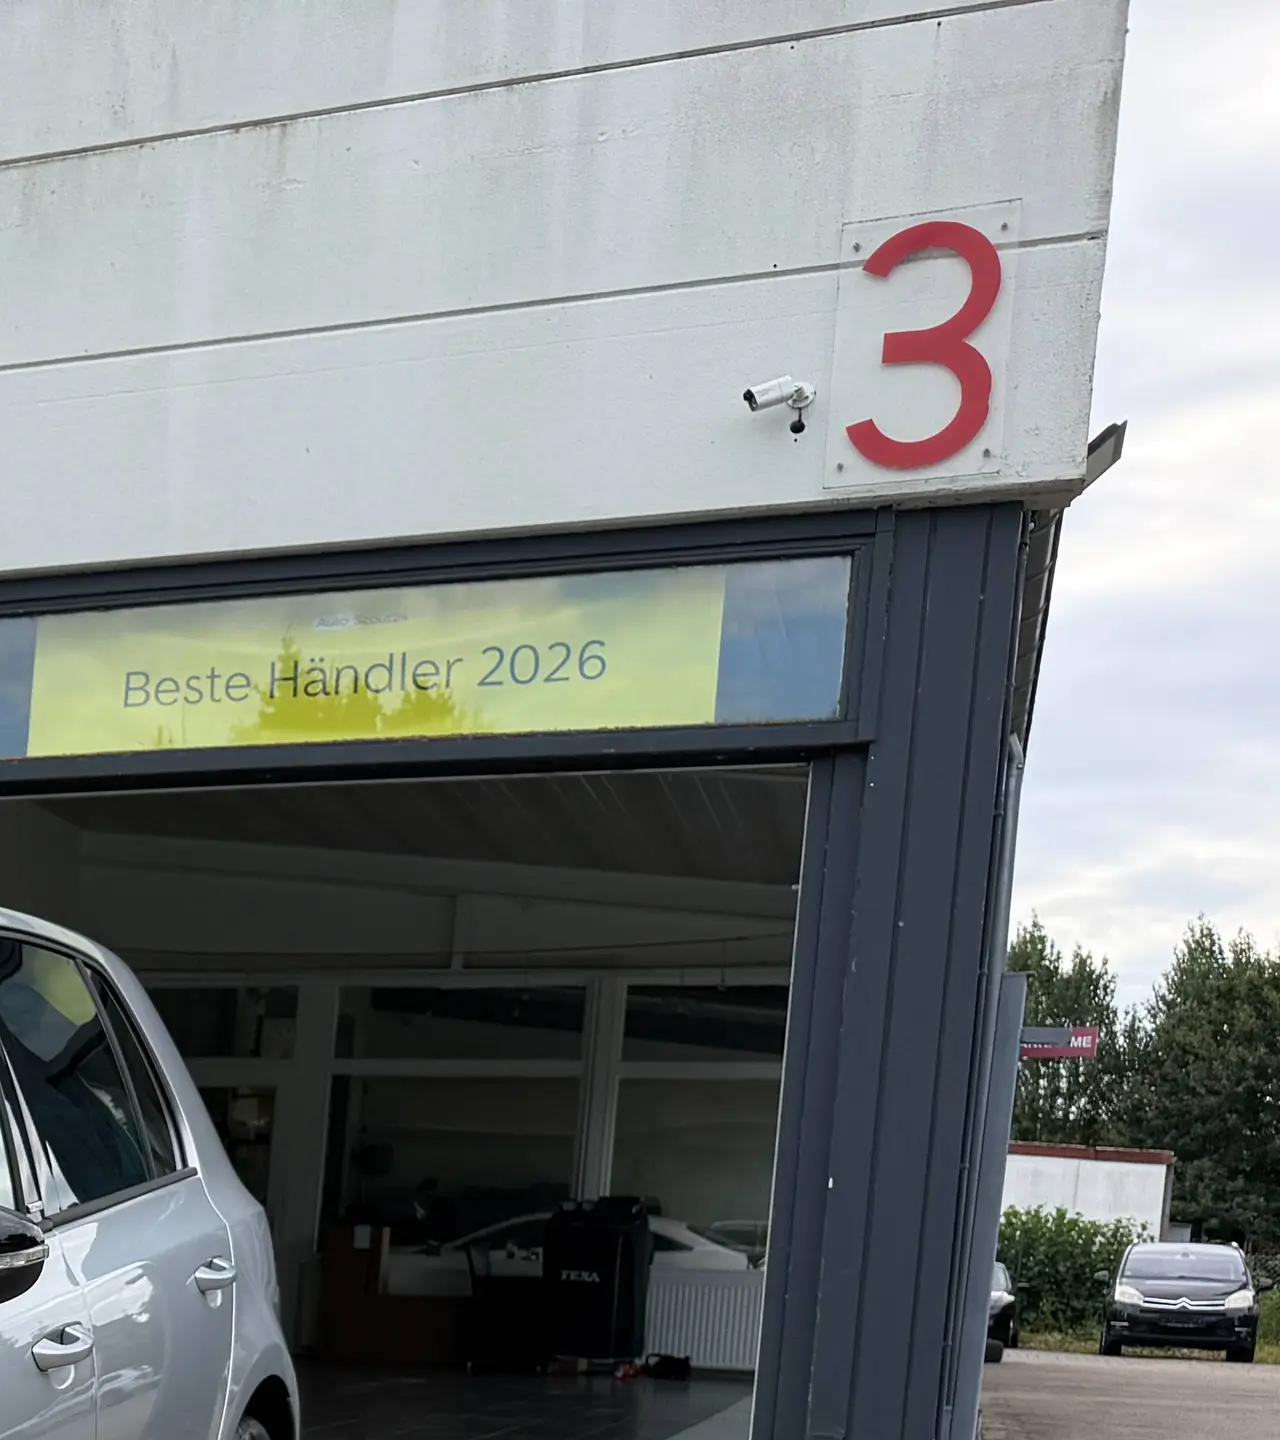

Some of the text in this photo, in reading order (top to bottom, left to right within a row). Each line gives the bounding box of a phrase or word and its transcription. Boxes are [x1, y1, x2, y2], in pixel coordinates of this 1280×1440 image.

[845, 221, 1002, 470] 3
[122, 639, 608, 708] Beste Händler 2026
